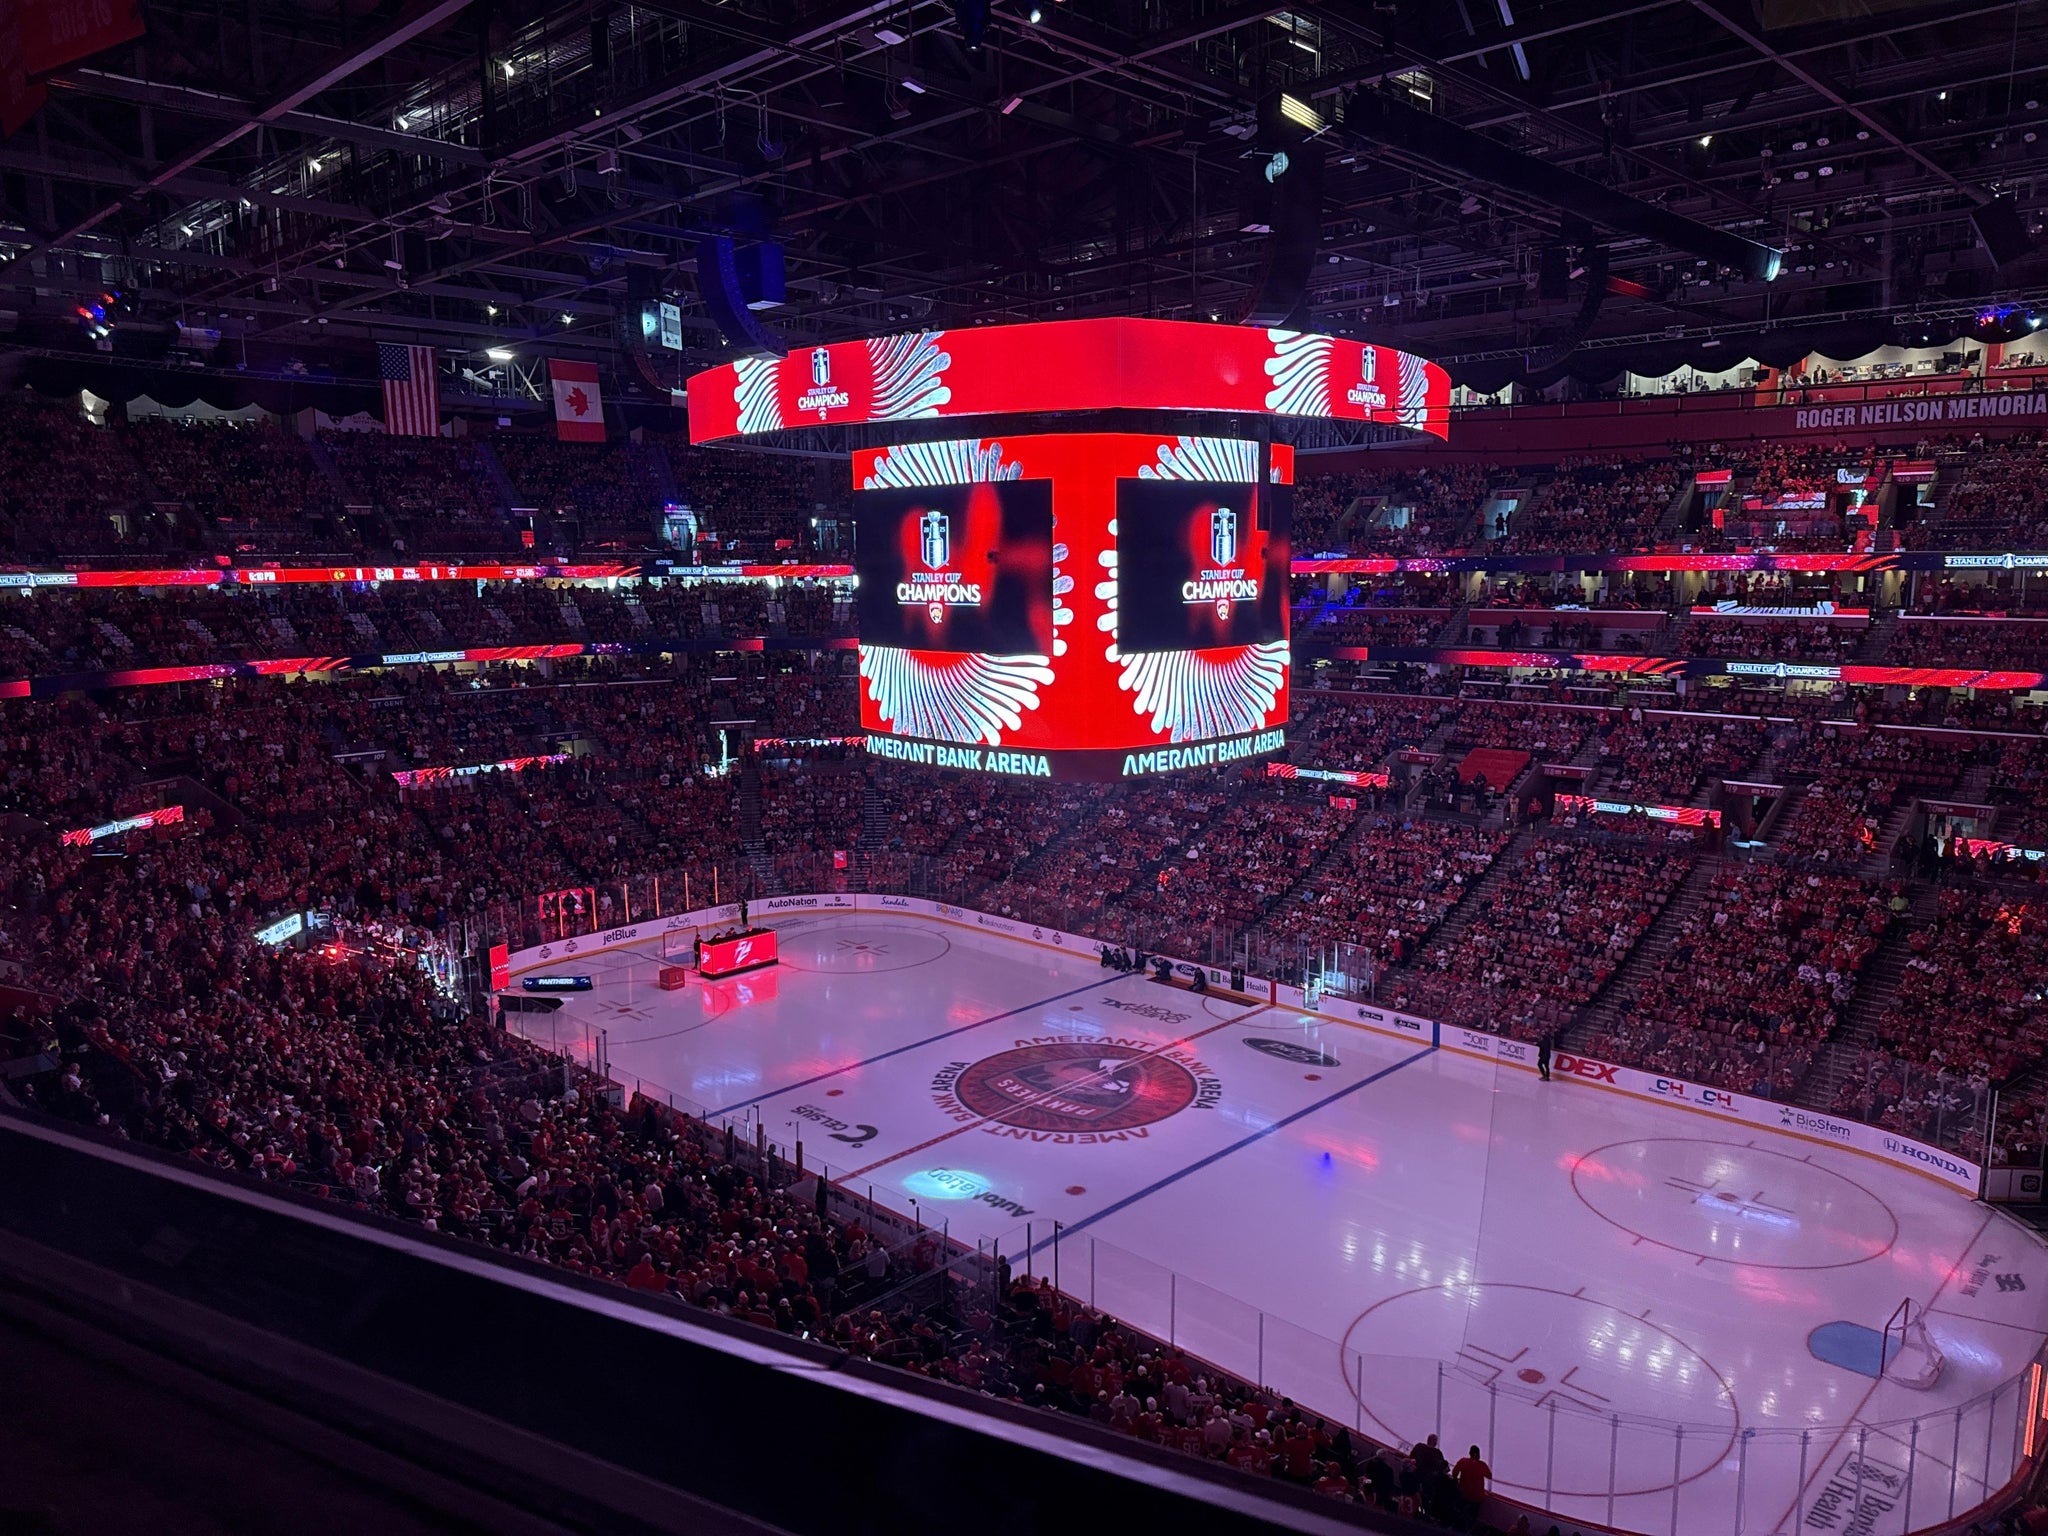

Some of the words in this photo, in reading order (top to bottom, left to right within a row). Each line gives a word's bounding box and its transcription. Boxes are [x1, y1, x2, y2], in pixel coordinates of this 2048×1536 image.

[797, 392, 849, 409] CHAMPIONS
[1347, 389, 1386, 405] CHAMPIONS
[1796, 406, 1856, 429] ROGER
[1861, 400, 1943, 425] NEILSON
[911, 573, 944, 583] STANLEY
[944, 573, 960, 583] CUP
[1200, 569, 1231, 580] STANLEY
[1231, 568, 1244, 579] CUP
[896, 582, 981, 603] CHAMPIONS
[1182, 579, 1258, 599] CHAMPIONS
[1786, 667, 1829, 675] CHAMPIONS
[866, 734, 935, 765] AMERANT
[936, 745, 982, 771] BANK
[984, 751, 1051, 777] ARENA
[1122, 743, 1217, 776] AMERANT
[1218, 736, 1252, 762] BANK
[1253, 729, 1285, 755] ARENA
[767, 897, 818, 909] AutoNation
[602, 927, 638, 946] jetBlue
[538, 978, 574, 986] PANTHERS
[1246, 980, 1269, 994] Health
[931, 1061, 971, 1092] ARENA
[1014, 1035, 1156, 1049] AMERANT
[1165, 1050, 1214, 1077] BANK
[1191, 1077, 1222, 1110] ARENA
[1553, 1053, 1621, 1085] DEX
[1656, 1078, 1684, 1095] CH
[997, 1079, 1096, 1117] PANTHERS
[1702, 1089, 1732, 1106] CH
[789, 1104, 849, 1132] CELSIUS
[932, 1094, 978, 1123] BANK
[981, 1126, 1150, 1145] AMERANT
[1796, 1113, 1851, 1138] BioStem
[1901, 1144, 1972, 1180] HONDA
[927, 1168, 1035, 1218] AutoNation
[1805, 1479, 1857, 1531] Health
